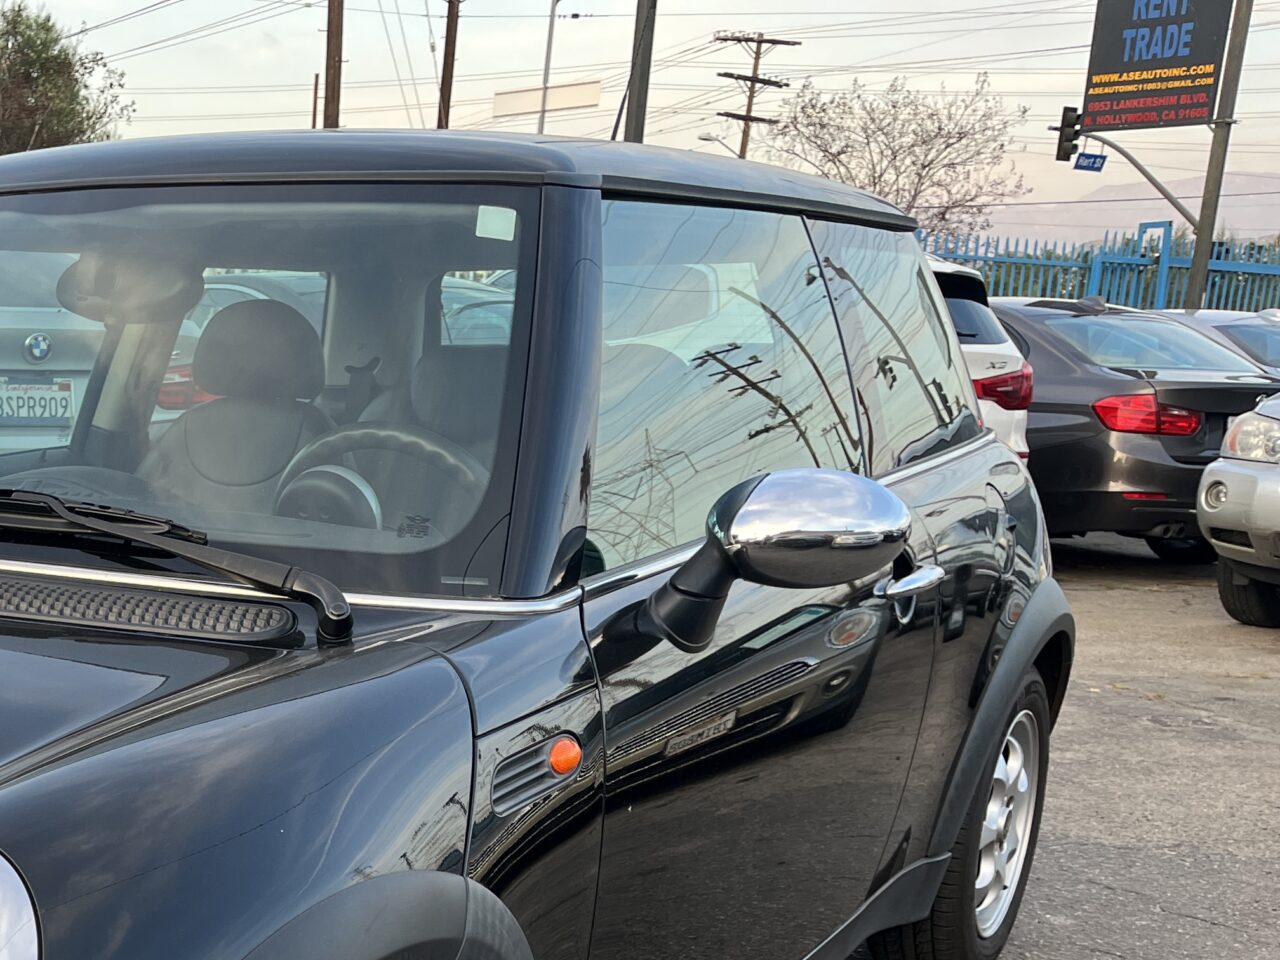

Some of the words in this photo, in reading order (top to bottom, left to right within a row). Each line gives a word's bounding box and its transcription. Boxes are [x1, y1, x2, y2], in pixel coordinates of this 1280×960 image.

[1122, 22, 1194, 63] TRADE
[1092, 64, 1215, 84] WWW.ASEAUTOINC.COM
[1113, 95, 1178, 110] LANKERSHIM
[1180, 92, 1209, 104] BLVD.
[1096, 111, 1159, 125] HOLLYWOOD,
[1161, 109, 1176, 120] CA
